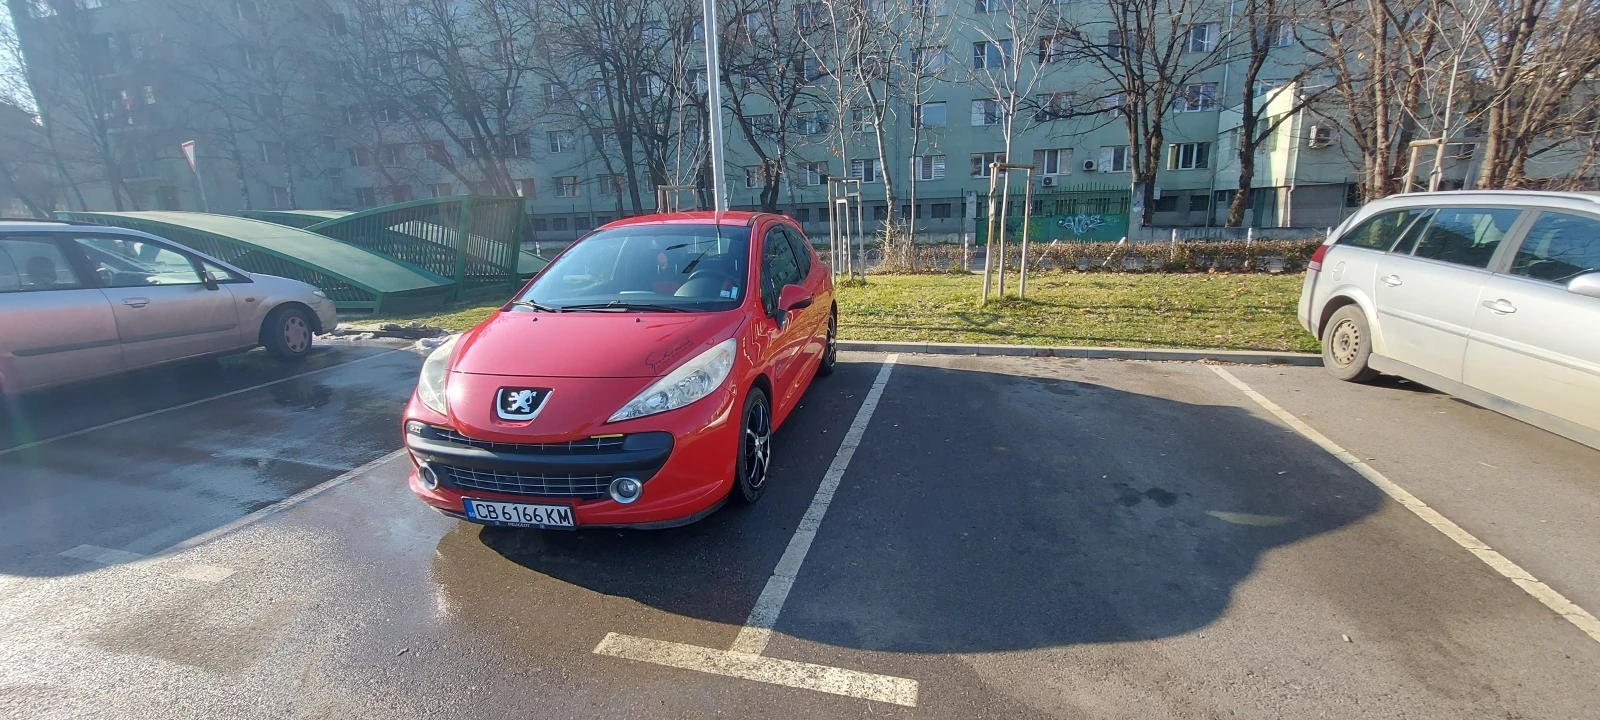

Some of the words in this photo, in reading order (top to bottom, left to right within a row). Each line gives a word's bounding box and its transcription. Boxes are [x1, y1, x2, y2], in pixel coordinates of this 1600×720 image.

[475, 503, 499, 520] CB
[501, 505, 544, 523] 6166
[545, 507, 572, 525] KM
